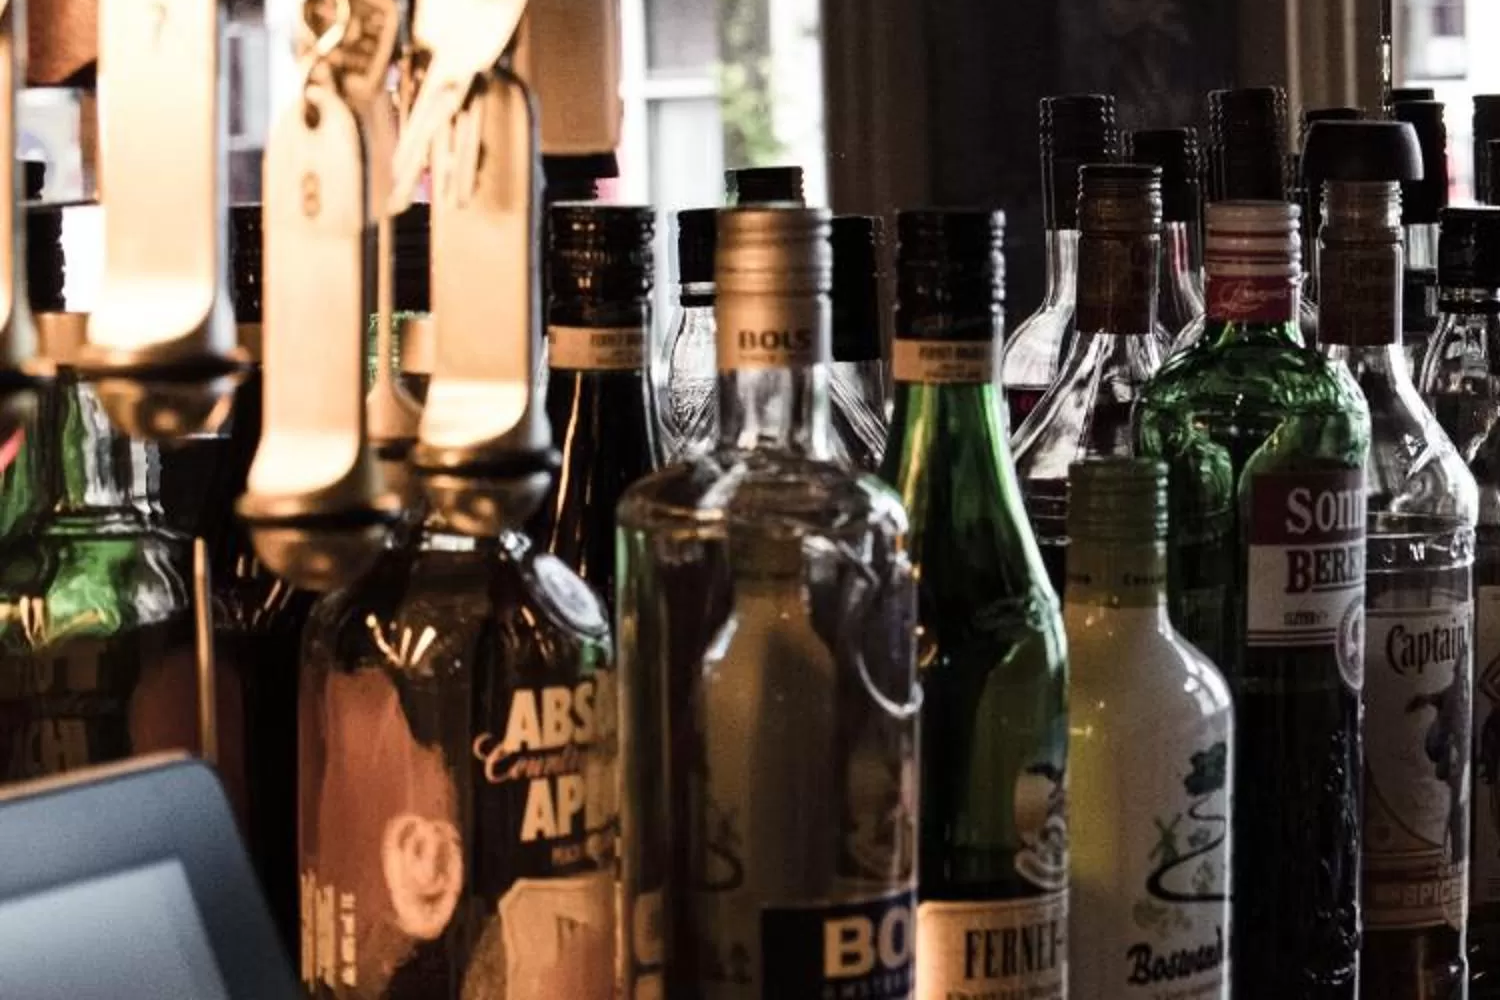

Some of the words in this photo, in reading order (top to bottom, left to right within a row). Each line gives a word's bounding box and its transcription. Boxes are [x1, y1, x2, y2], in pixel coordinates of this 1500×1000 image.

[738, 329, 812, 352] BOLS
[1385, 616, 1465, 676] Captain
[503, 682, 597, 753] ABS
